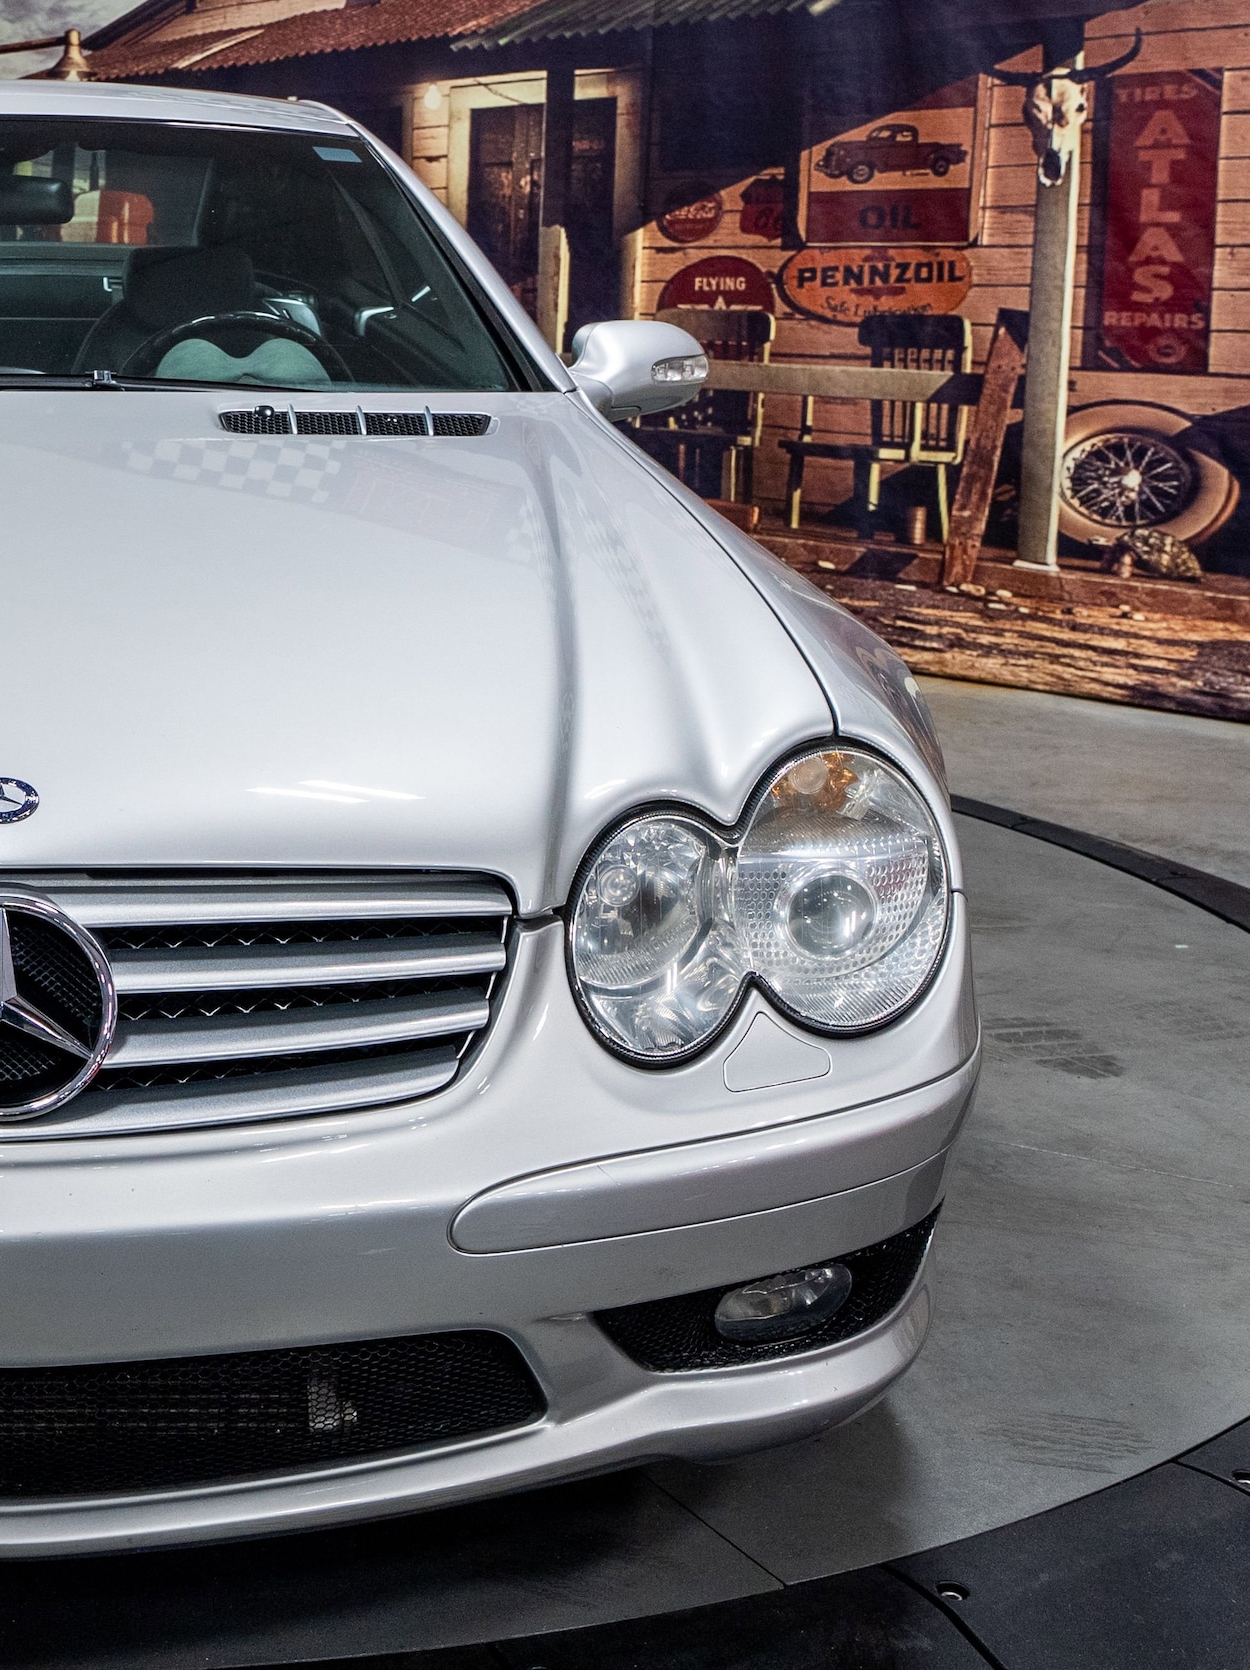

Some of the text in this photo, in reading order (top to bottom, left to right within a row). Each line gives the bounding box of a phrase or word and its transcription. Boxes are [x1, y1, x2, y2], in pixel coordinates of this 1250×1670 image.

[1117, 83, 1199, 102] TIRES
[859, 204, 922, 229] OIL
[1128, 109, 1191, 303] ATLAS
[694, 276, 746, 291] FLYING
[797, 260, 965, 289] PENNZOIL
[1103, 311, 1205, 329] REPAIRS
